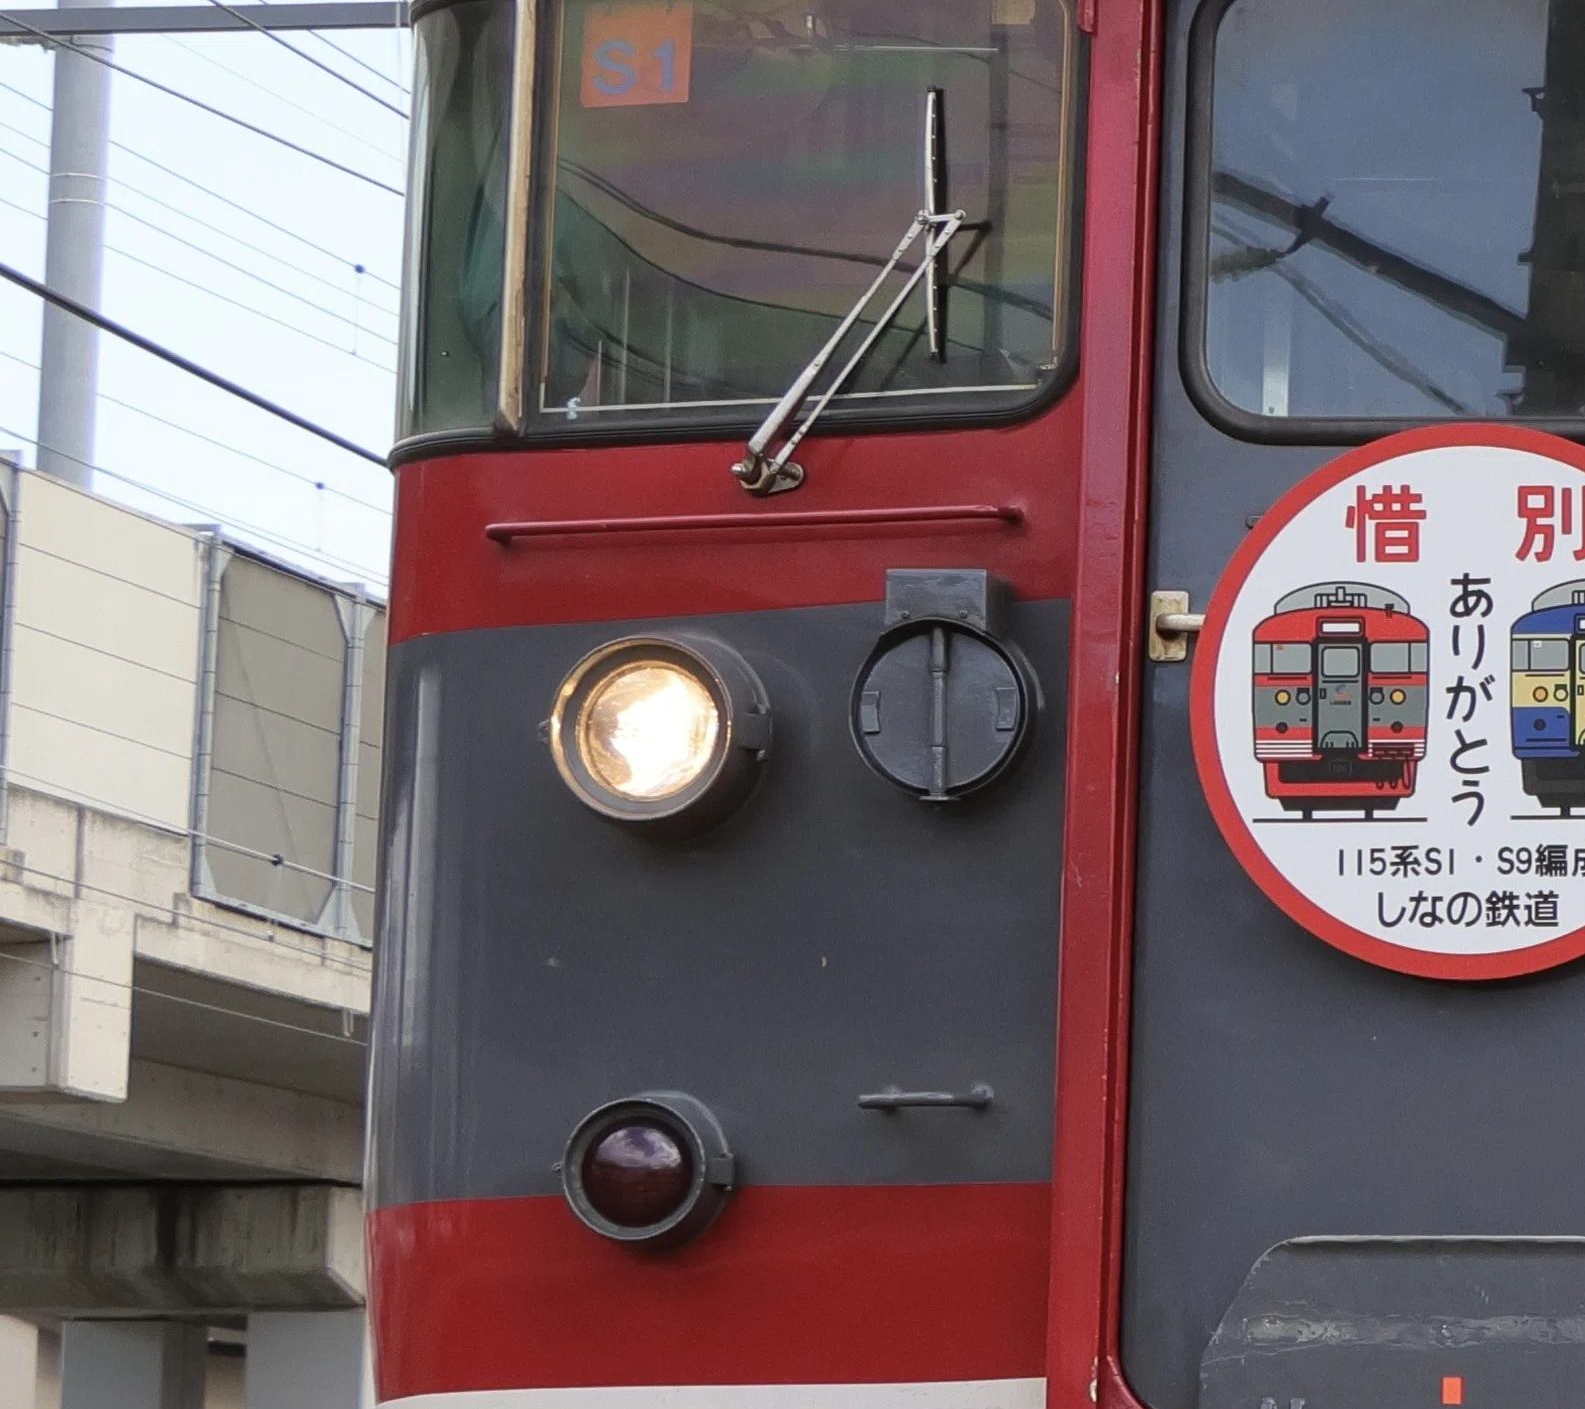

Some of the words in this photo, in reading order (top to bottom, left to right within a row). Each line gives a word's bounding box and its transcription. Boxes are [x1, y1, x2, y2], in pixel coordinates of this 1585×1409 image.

[592, 39, 676, 96] S1
[1445, 571, 1496, 828] ありがとう
[1376, 889, 1560, 929] しなの鉄道
